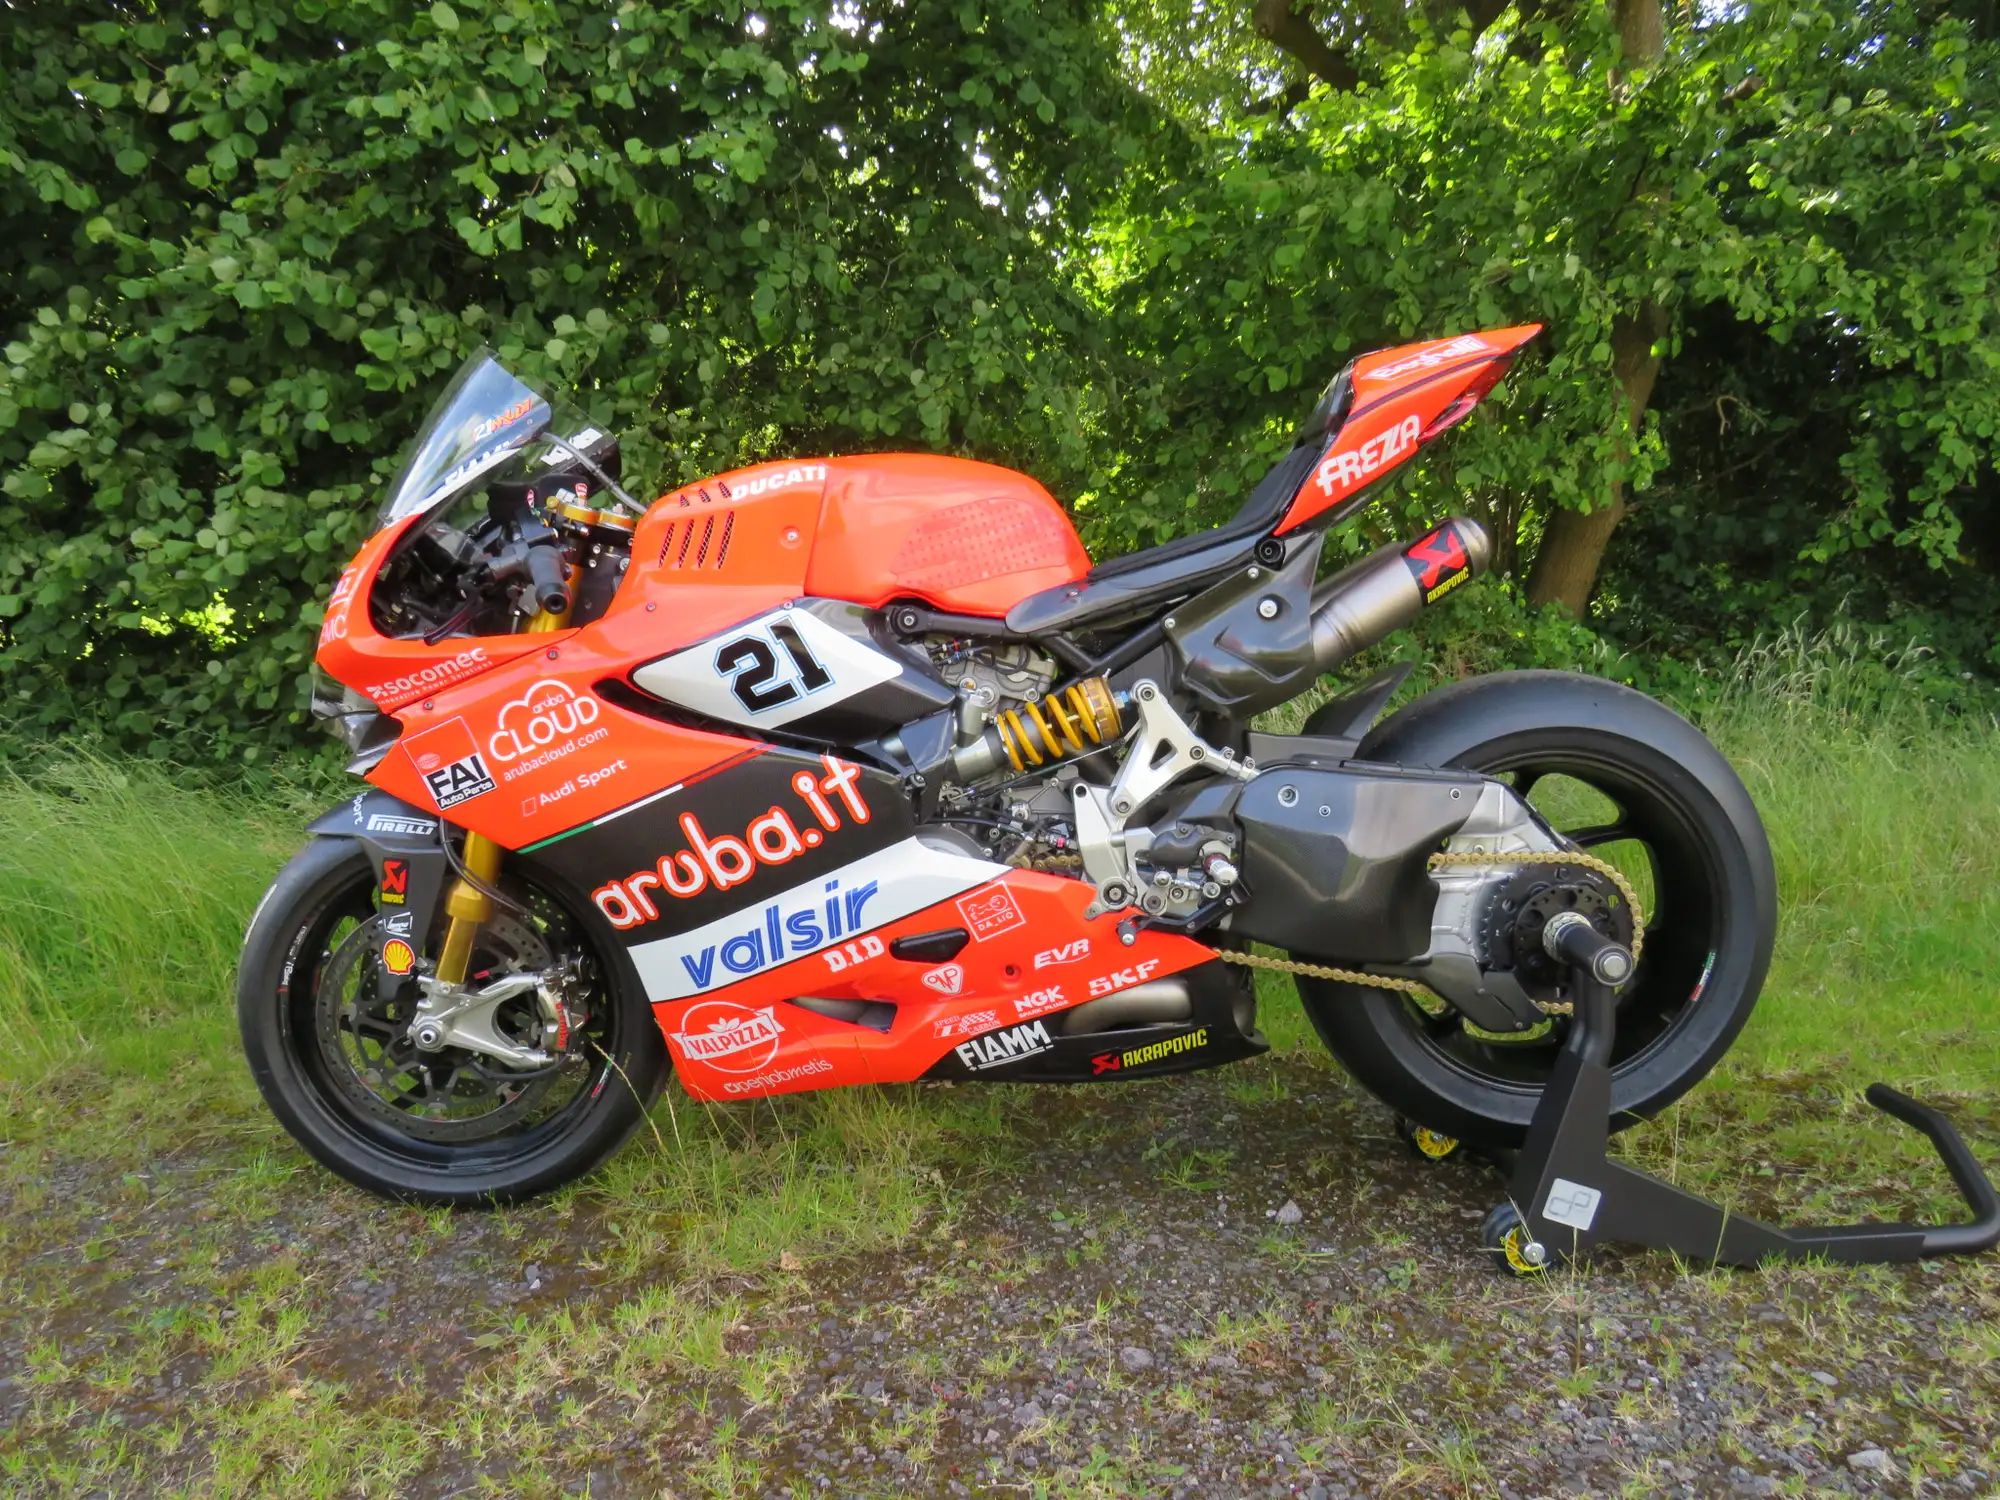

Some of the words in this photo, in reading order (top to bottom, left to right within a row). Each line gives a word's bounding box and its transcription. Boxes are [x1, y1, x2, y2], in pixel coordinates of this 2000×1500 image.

[1315, 414, 1420, 497] FREZA
[731, 465, 826, 501] DUCATI
[383, 647, 487, 694] socomec
[714, 616, 834, 714] 21
[532, 693, 565, 714] aruba
[489, 696, 598, 761] CLOUD
[503, 727, 609, 781] arubacloud.com
[426, 755, 487, 797] FAI
[440, 792, 465, 807] Auto
[462, 781, 493, 797] Parts
[539, 780, 577, 806] Audi
[576, 759, 628, 788] Sport
[366, 813, 439, 836] PIRELLI
[591, 754, 871, 930] aruba.it
[680, 879, 879, 990] valsir
[822, 935, 885, 972] D.I.D
[1033, 938, 1090, 970] EVR
[1088, 958, 1160, 996] SKF
[1013, 985, 1065, 1012] NGK
[1018, 1008, 1043, 1019] SPARK
[688, 1022, 773, 1055] VALPIZZA
[955, 1020, 1052, 1068] FIAMM
[723, 1058, 834, 1093] openjobmetis
